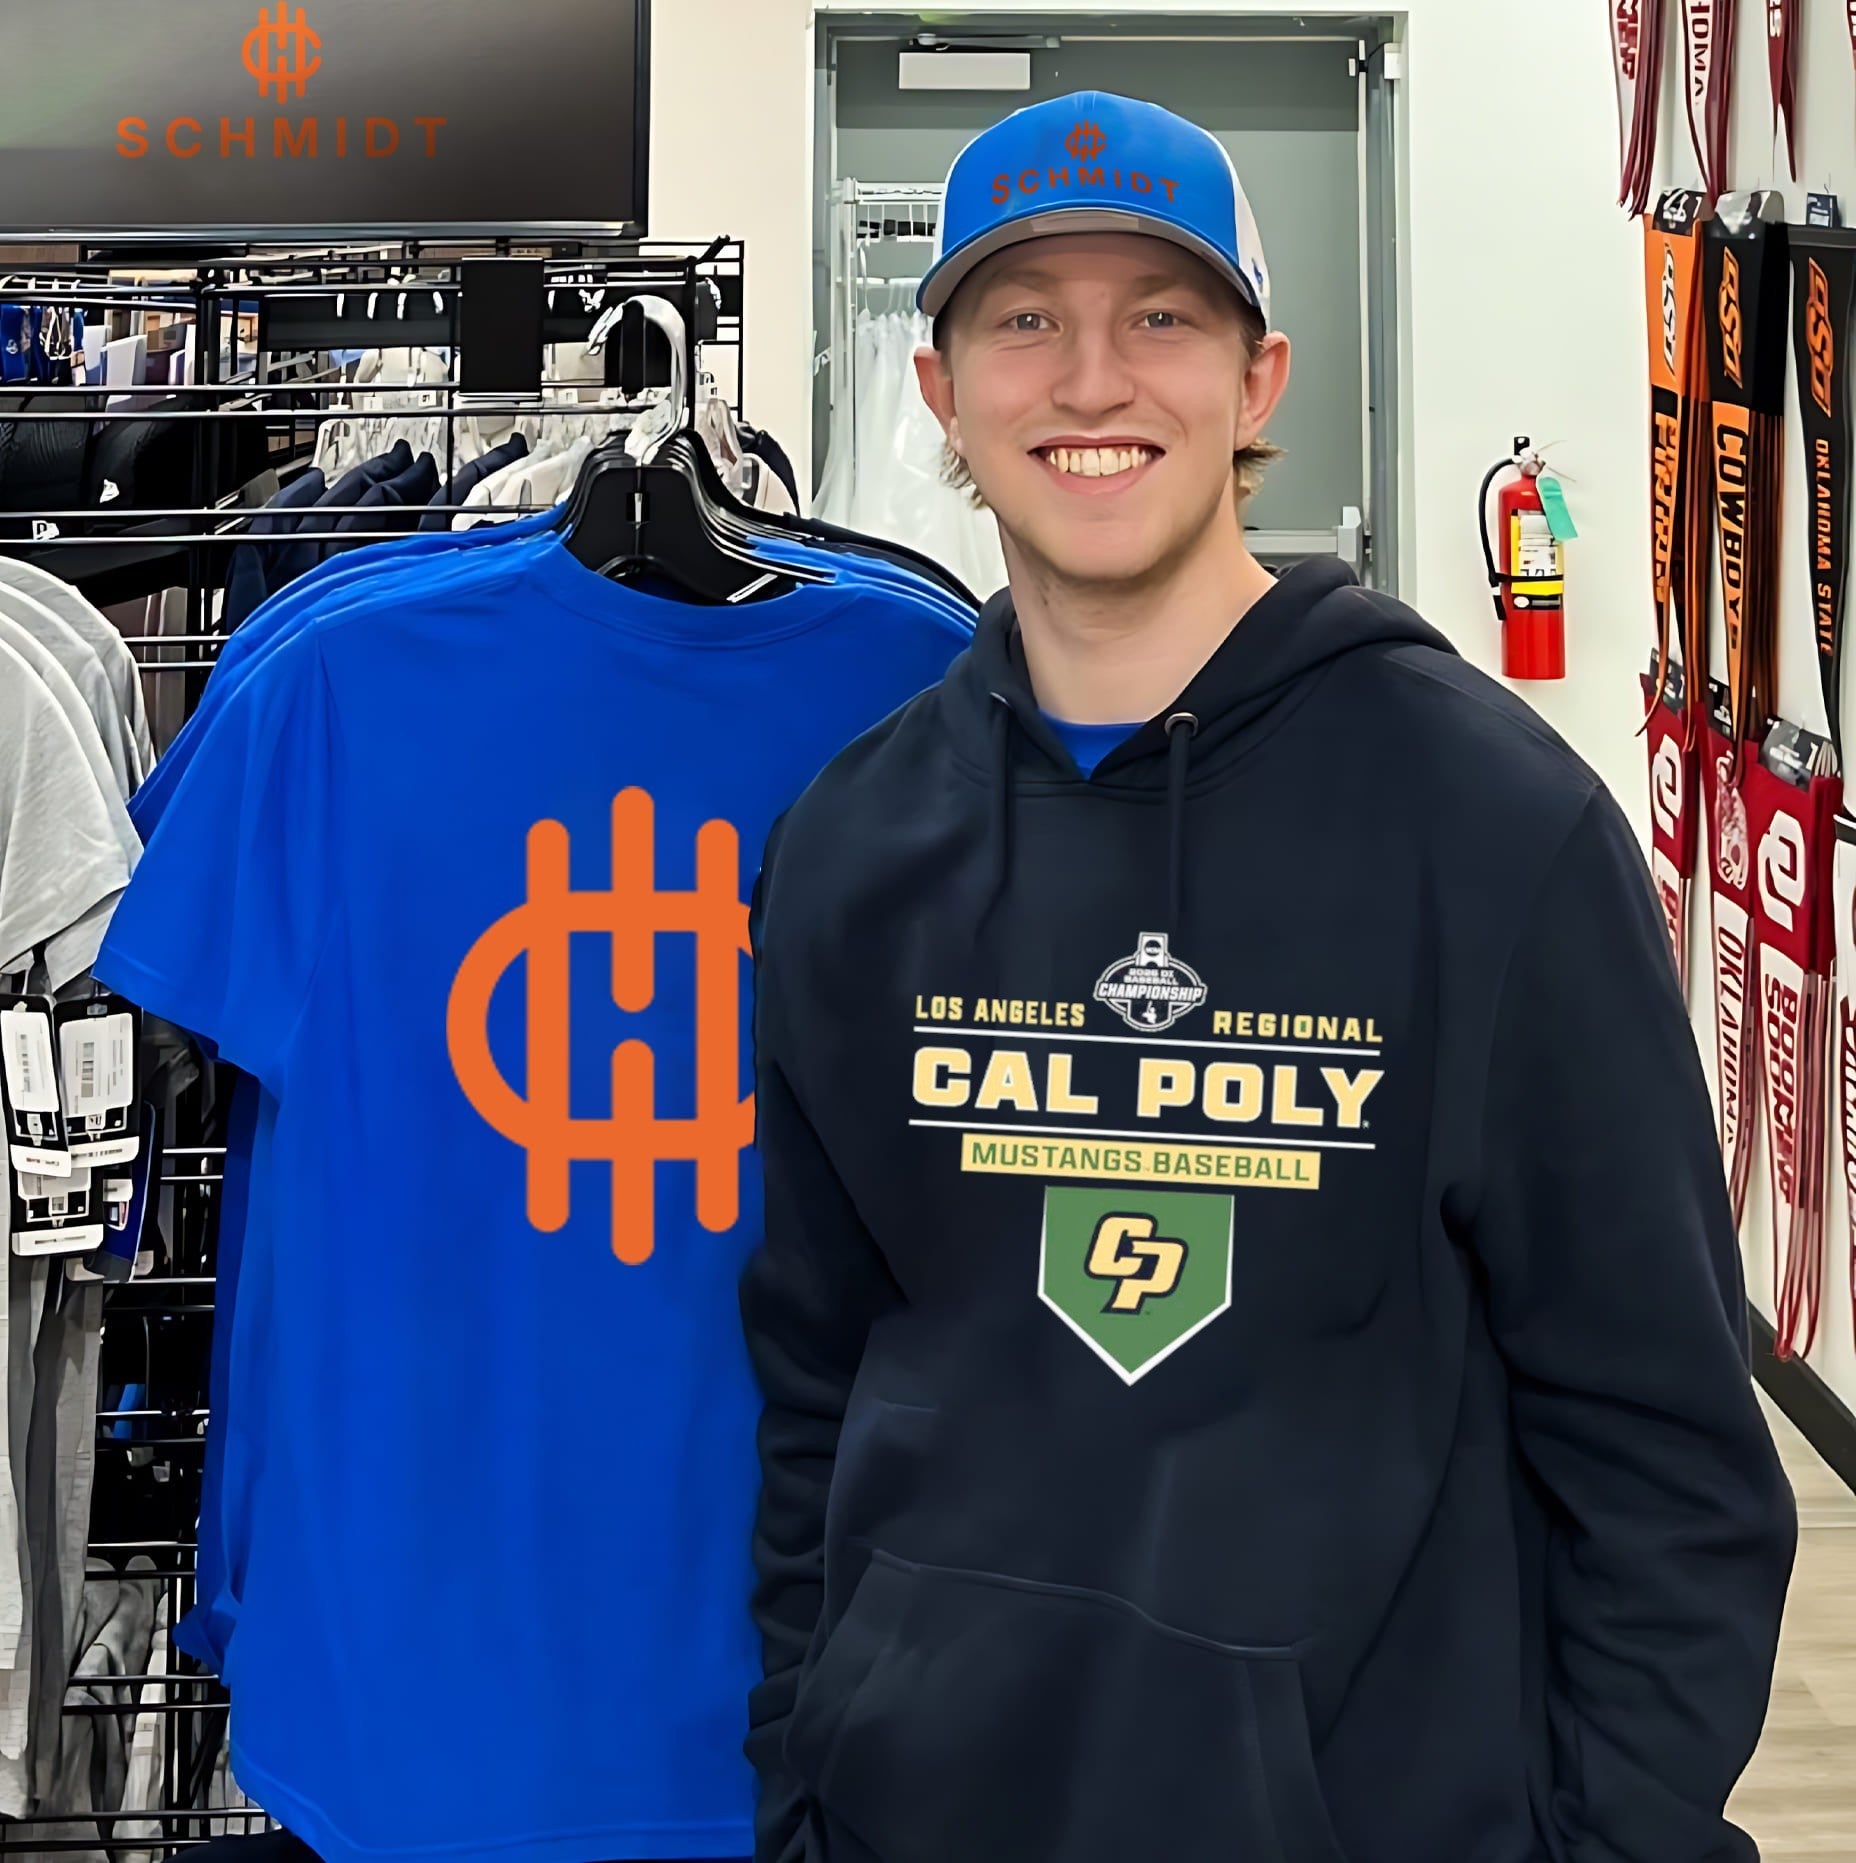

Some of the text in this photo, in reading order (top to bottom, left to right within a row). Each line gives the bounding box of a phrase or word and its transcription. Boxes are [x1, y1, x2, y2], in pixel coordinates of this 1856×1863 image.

[115, 116, 447, 159] SCHMIDT
[991, 167, 1179, 205] SCHMIDT
[1815, 438, 1831, 571] OKLAHOMA
[1098, 983, 1203, 1002] CHAMPIONSHIP
[1123, 975, 1179, 985] BASEBALL
[915, 994, 1383, 1043] LOS ANGELES REGIONAL
[1718, 926, 1745, 1144] OKLAHOMA
[912, 1046, 1385, 1129] CAL POLY
[971, 1142, 1310, 1182] MUSTANGS BASEBALL
